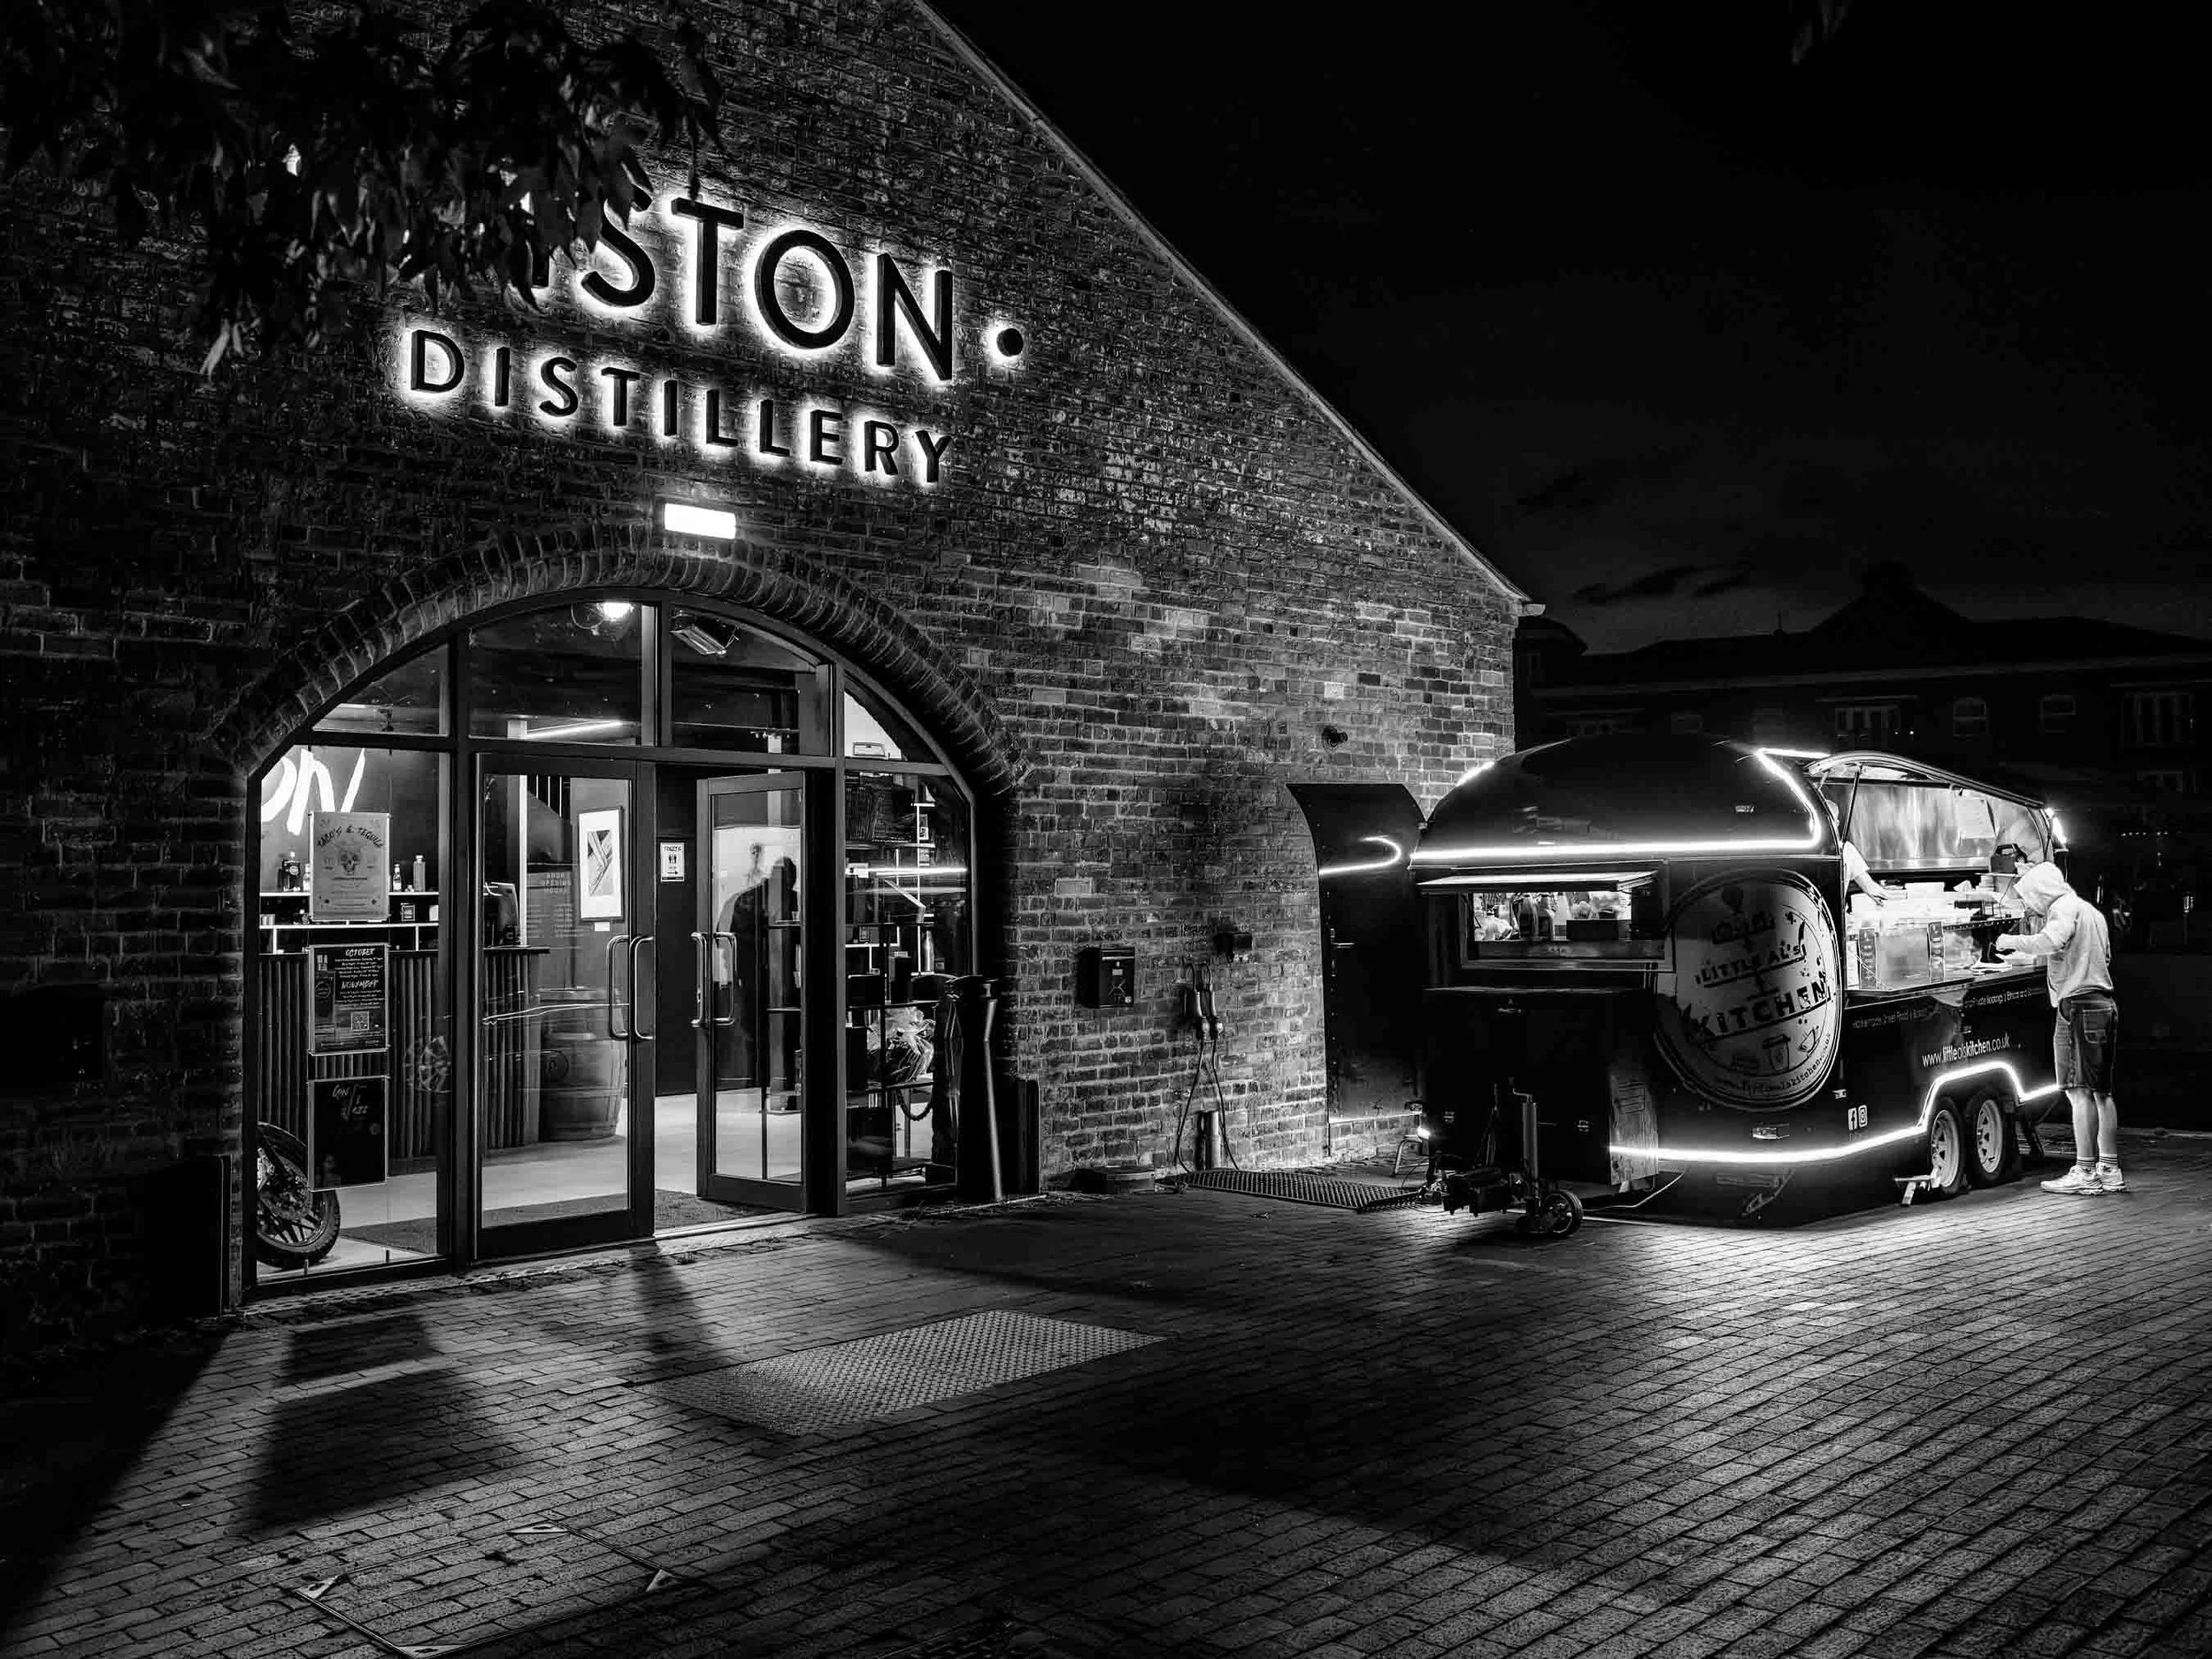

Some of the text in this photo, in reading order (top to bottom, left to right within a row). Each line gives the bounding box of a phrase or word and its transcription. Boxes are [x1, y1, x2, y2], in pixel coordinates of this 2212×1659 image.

[533, 184, 954, 381] STON
[411, 329, 953, 483] DISTILLERY
[345, 948, 376, 957] OCTOBER
[1700, 943, 1801, 982] LITTLE AL'S
[1683, 977, 1828, 1041] KITCHEN
